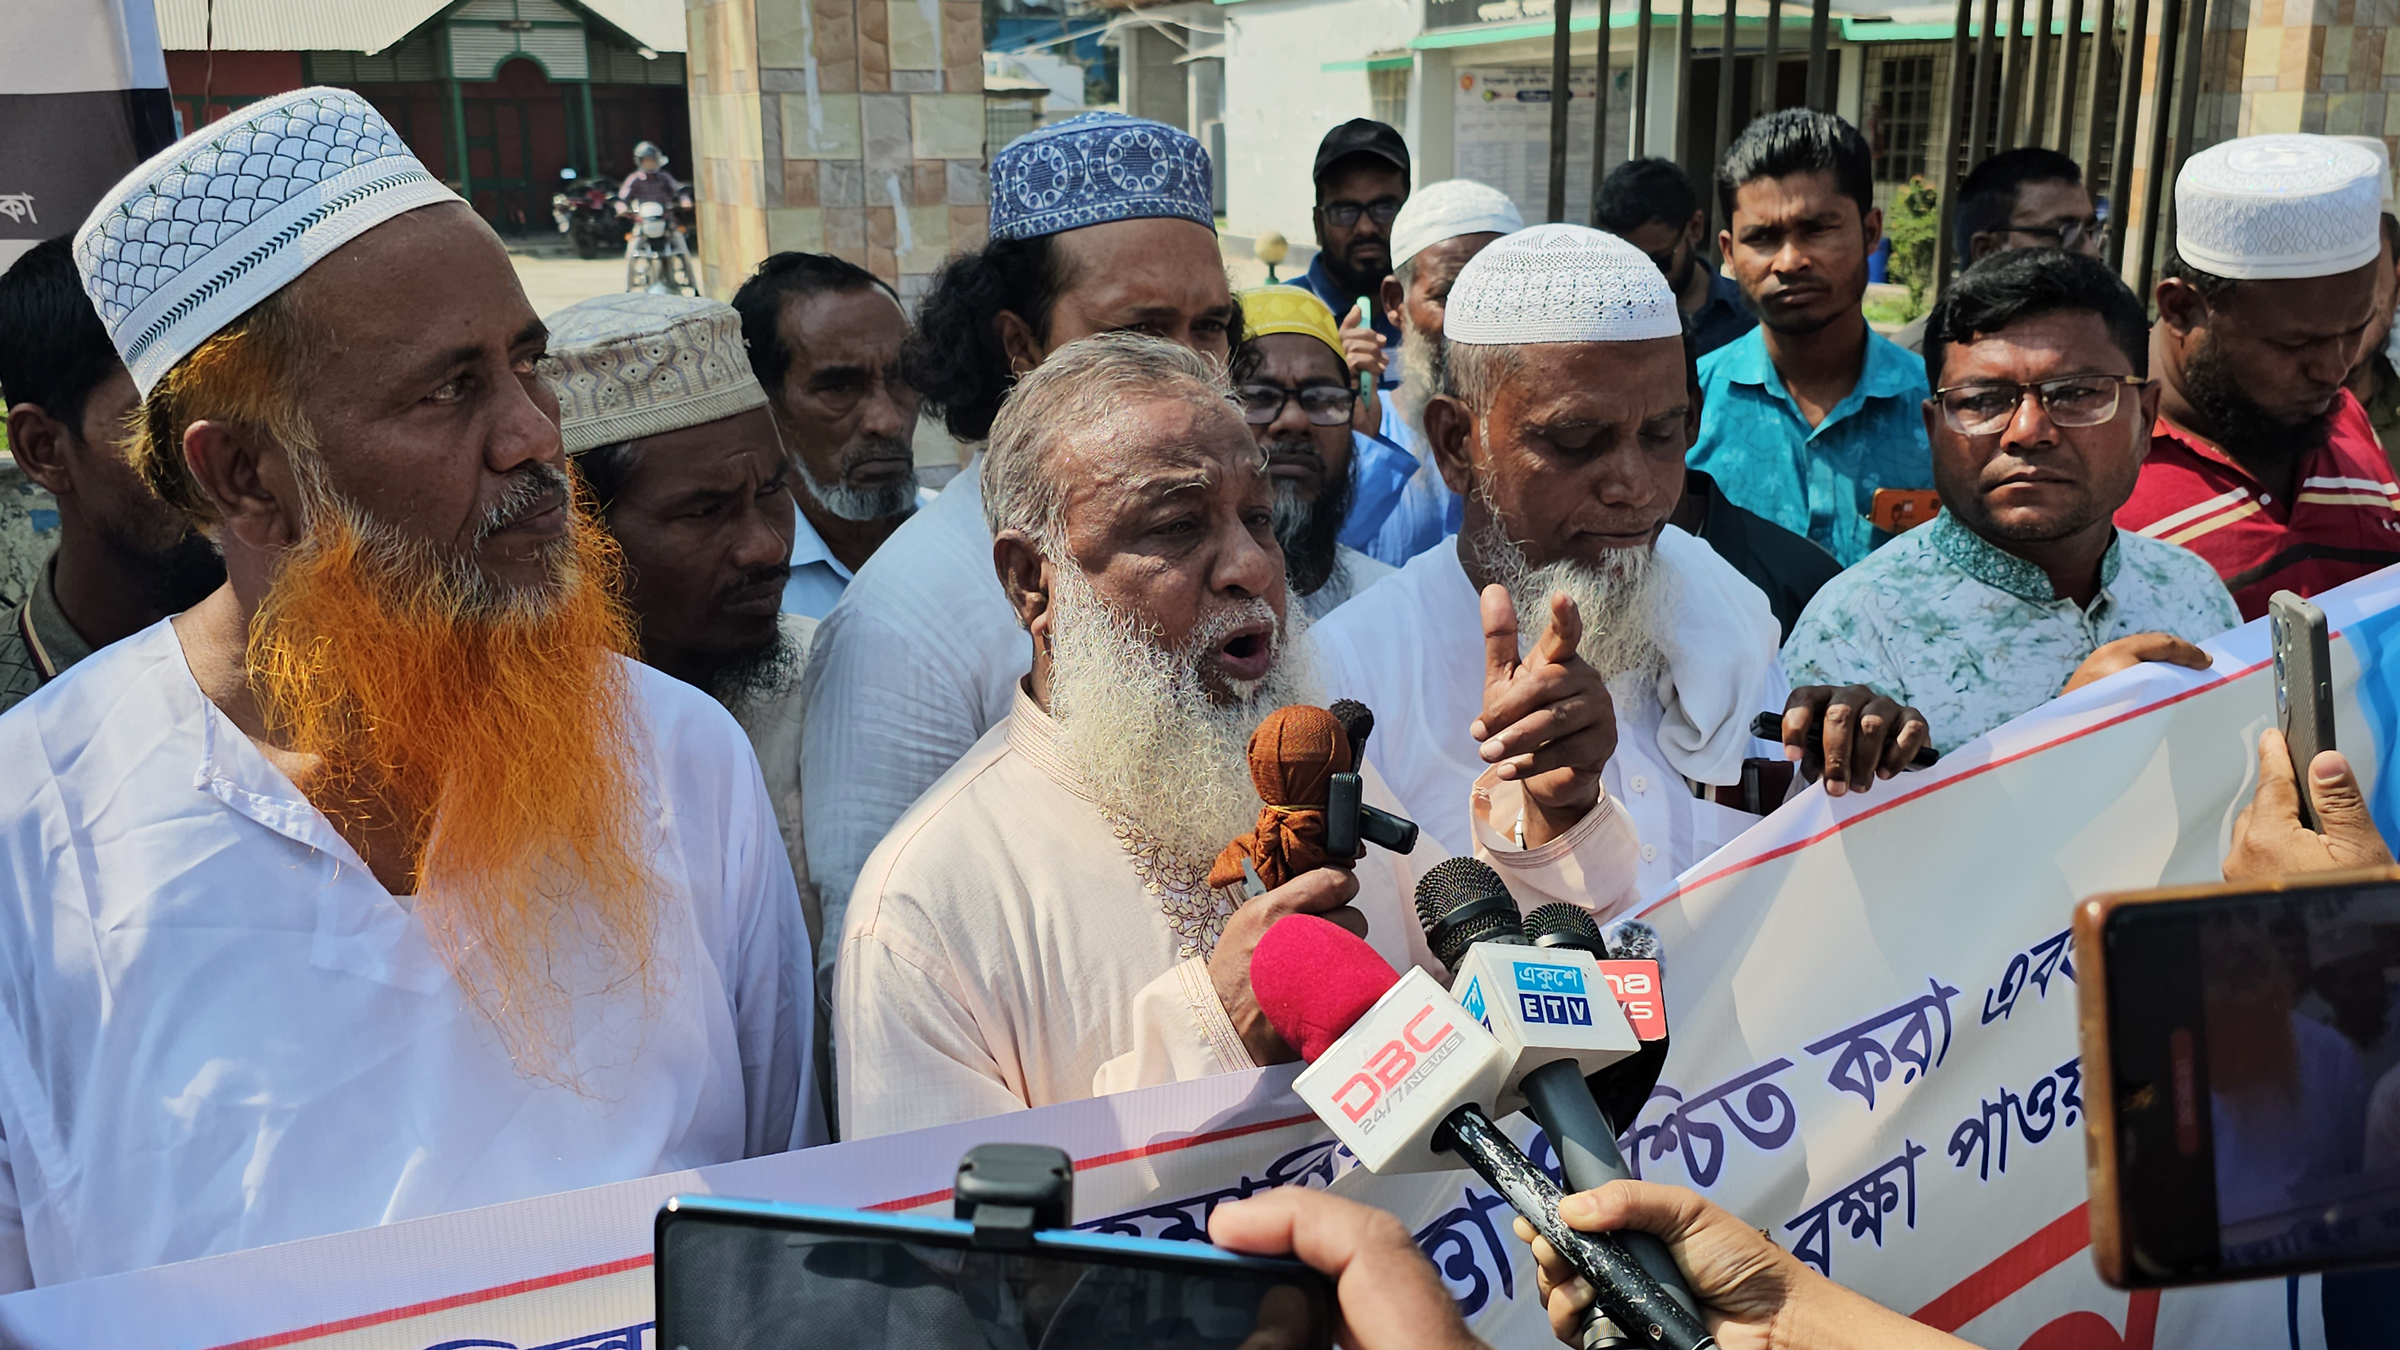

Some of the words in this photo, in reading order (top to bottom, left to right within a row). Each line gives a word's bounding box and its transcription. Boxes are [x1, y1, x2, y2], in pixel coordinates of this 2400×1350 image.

[0, 191, 38, 225] কা
[1518, 966, 1578, 990] একুশে
[1522, 997, 1586, 1020] ETV
[1331, 1003, 1454, 1124] DBC
[1803, 977, 1961, 1111] করা
[1947, 1055, 2086, 1182] পাওয়
